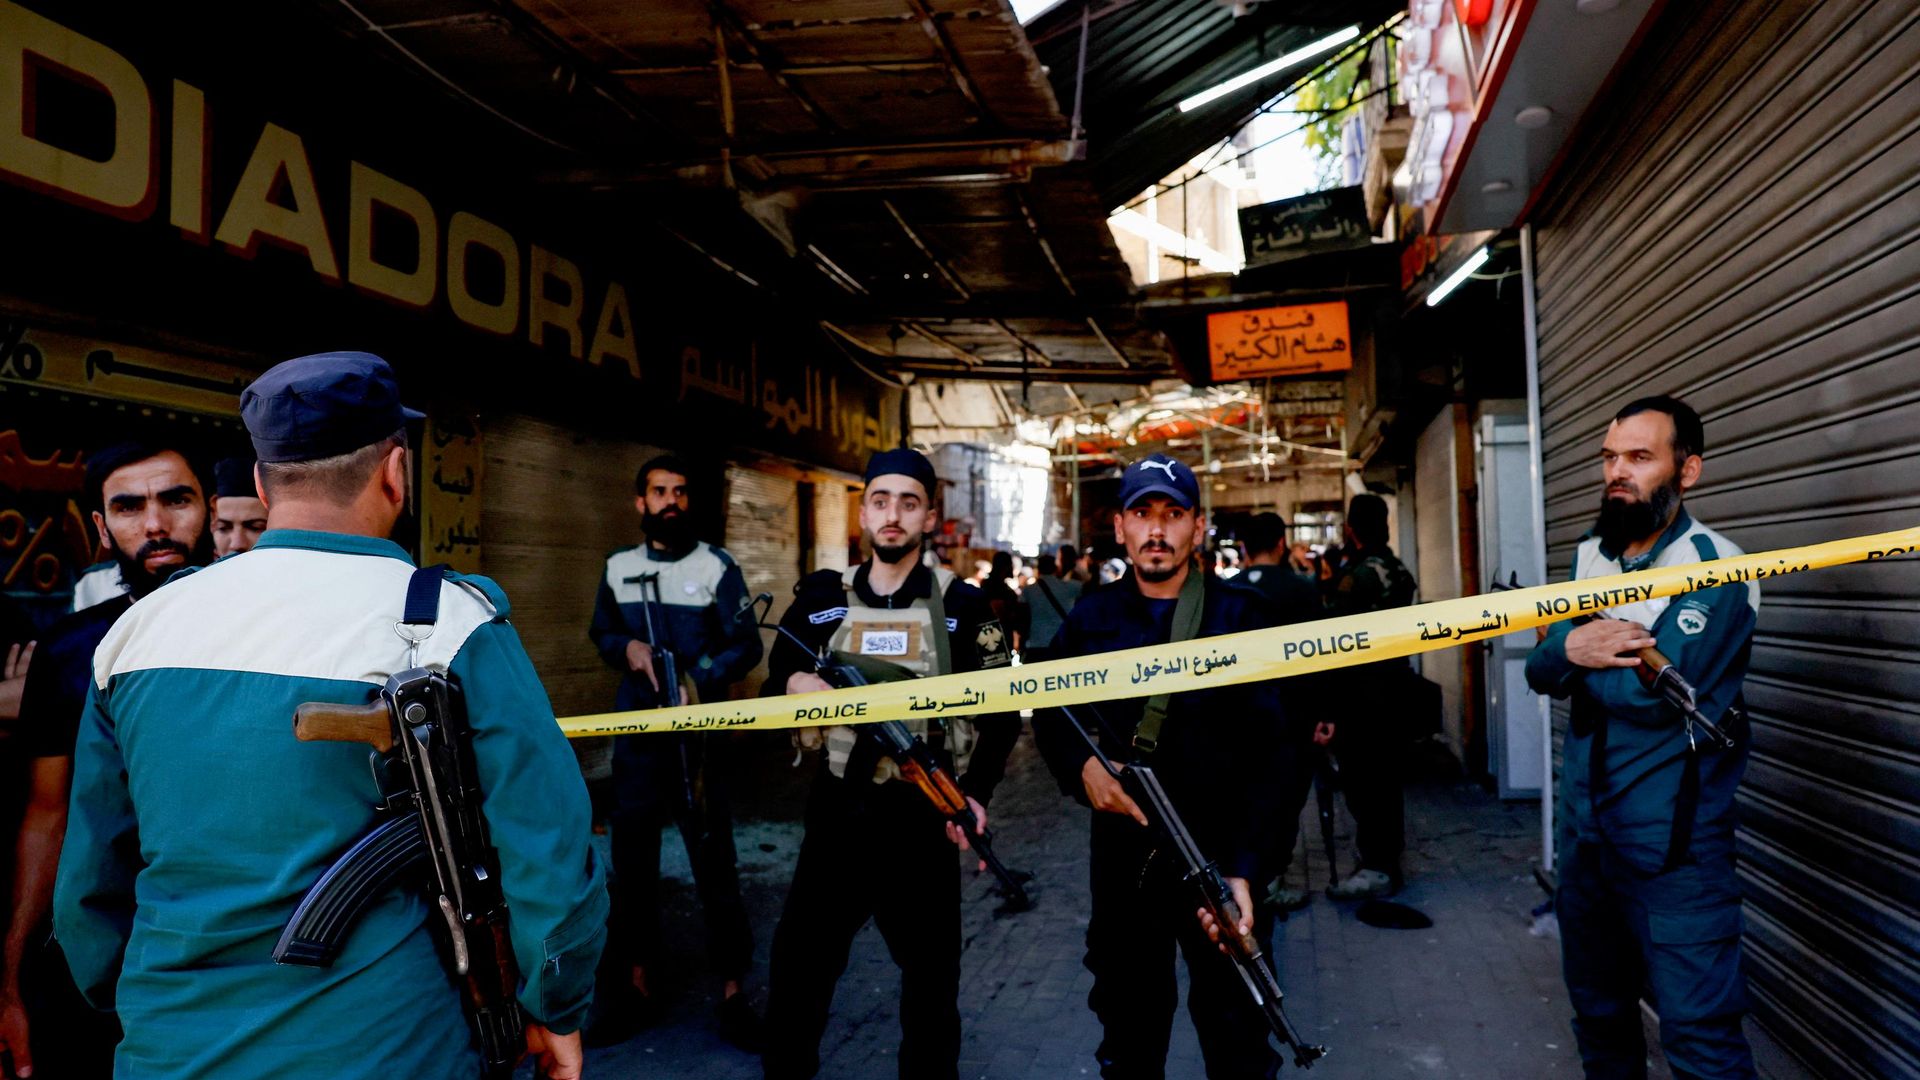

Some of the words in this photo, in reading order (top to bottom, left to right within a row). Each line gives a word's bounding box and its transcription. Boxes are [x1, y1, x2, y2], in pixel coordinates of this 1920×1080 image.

[0, 0, 643, 380] DIADORA
[1242, 309, 1314, 334] فندق
[1292, 332, 1346, 361] هشام
[1536, 598, 1570, 618] NO
[1577, 584, 1654, 611] ENTRY
[1418, 609, 1509, 641] الشرطة
[1283, 631, 1371, 661] POLICE
[1131, 655, 1188, 684] الدخول
[1192, 649, 1238, 676] ممنوع
[1009, 678, 1038, 696] NO
[1044, 669, 1109, 692] ENTRY
[794, 702, 868, 721] POLICE
[908, 687, 986, 712] الشرطة
